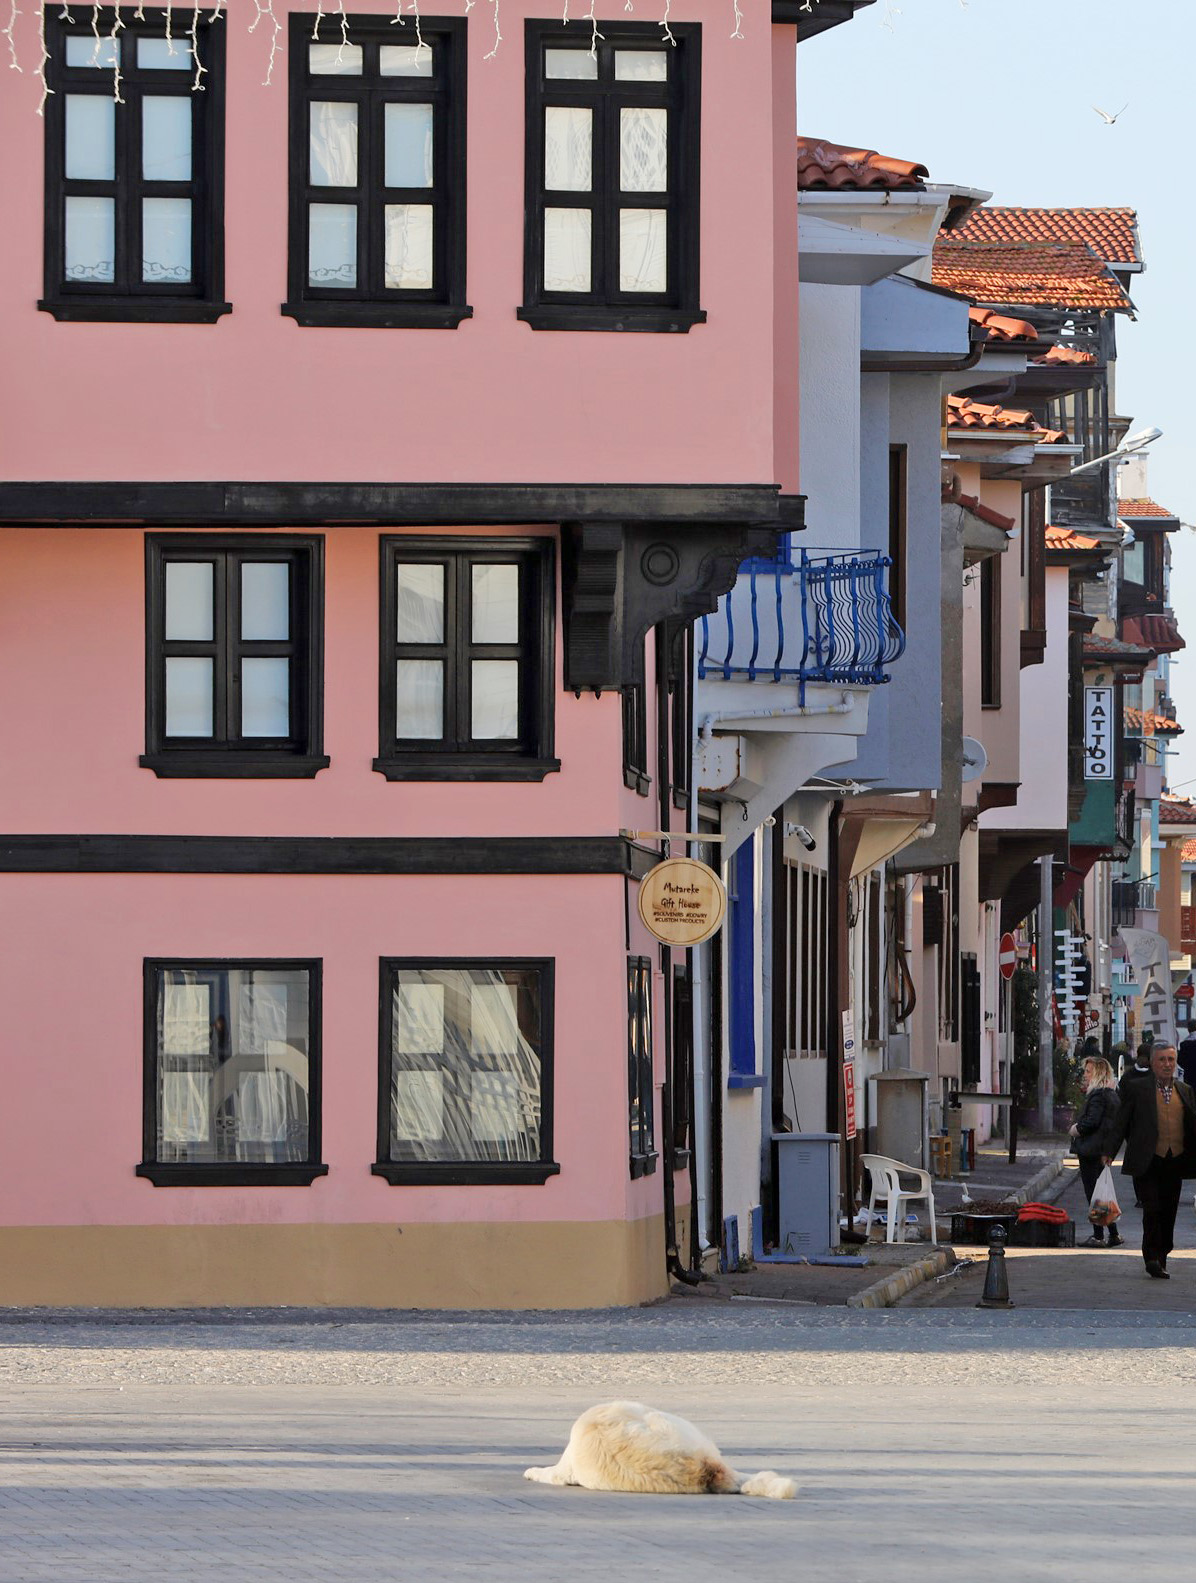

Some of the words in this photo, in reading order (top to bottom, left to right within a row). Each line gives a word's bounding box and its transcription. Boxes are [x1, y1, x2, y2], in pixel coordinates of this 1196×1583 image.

[1090, 691, 1106, 774] TATTOO
[661, 898, 676, 909] Gift
[679, 898, 702, 909] House
[663, 882, 700, 895] Mutareke
[1141, 961, 1169, 1044] TATT
